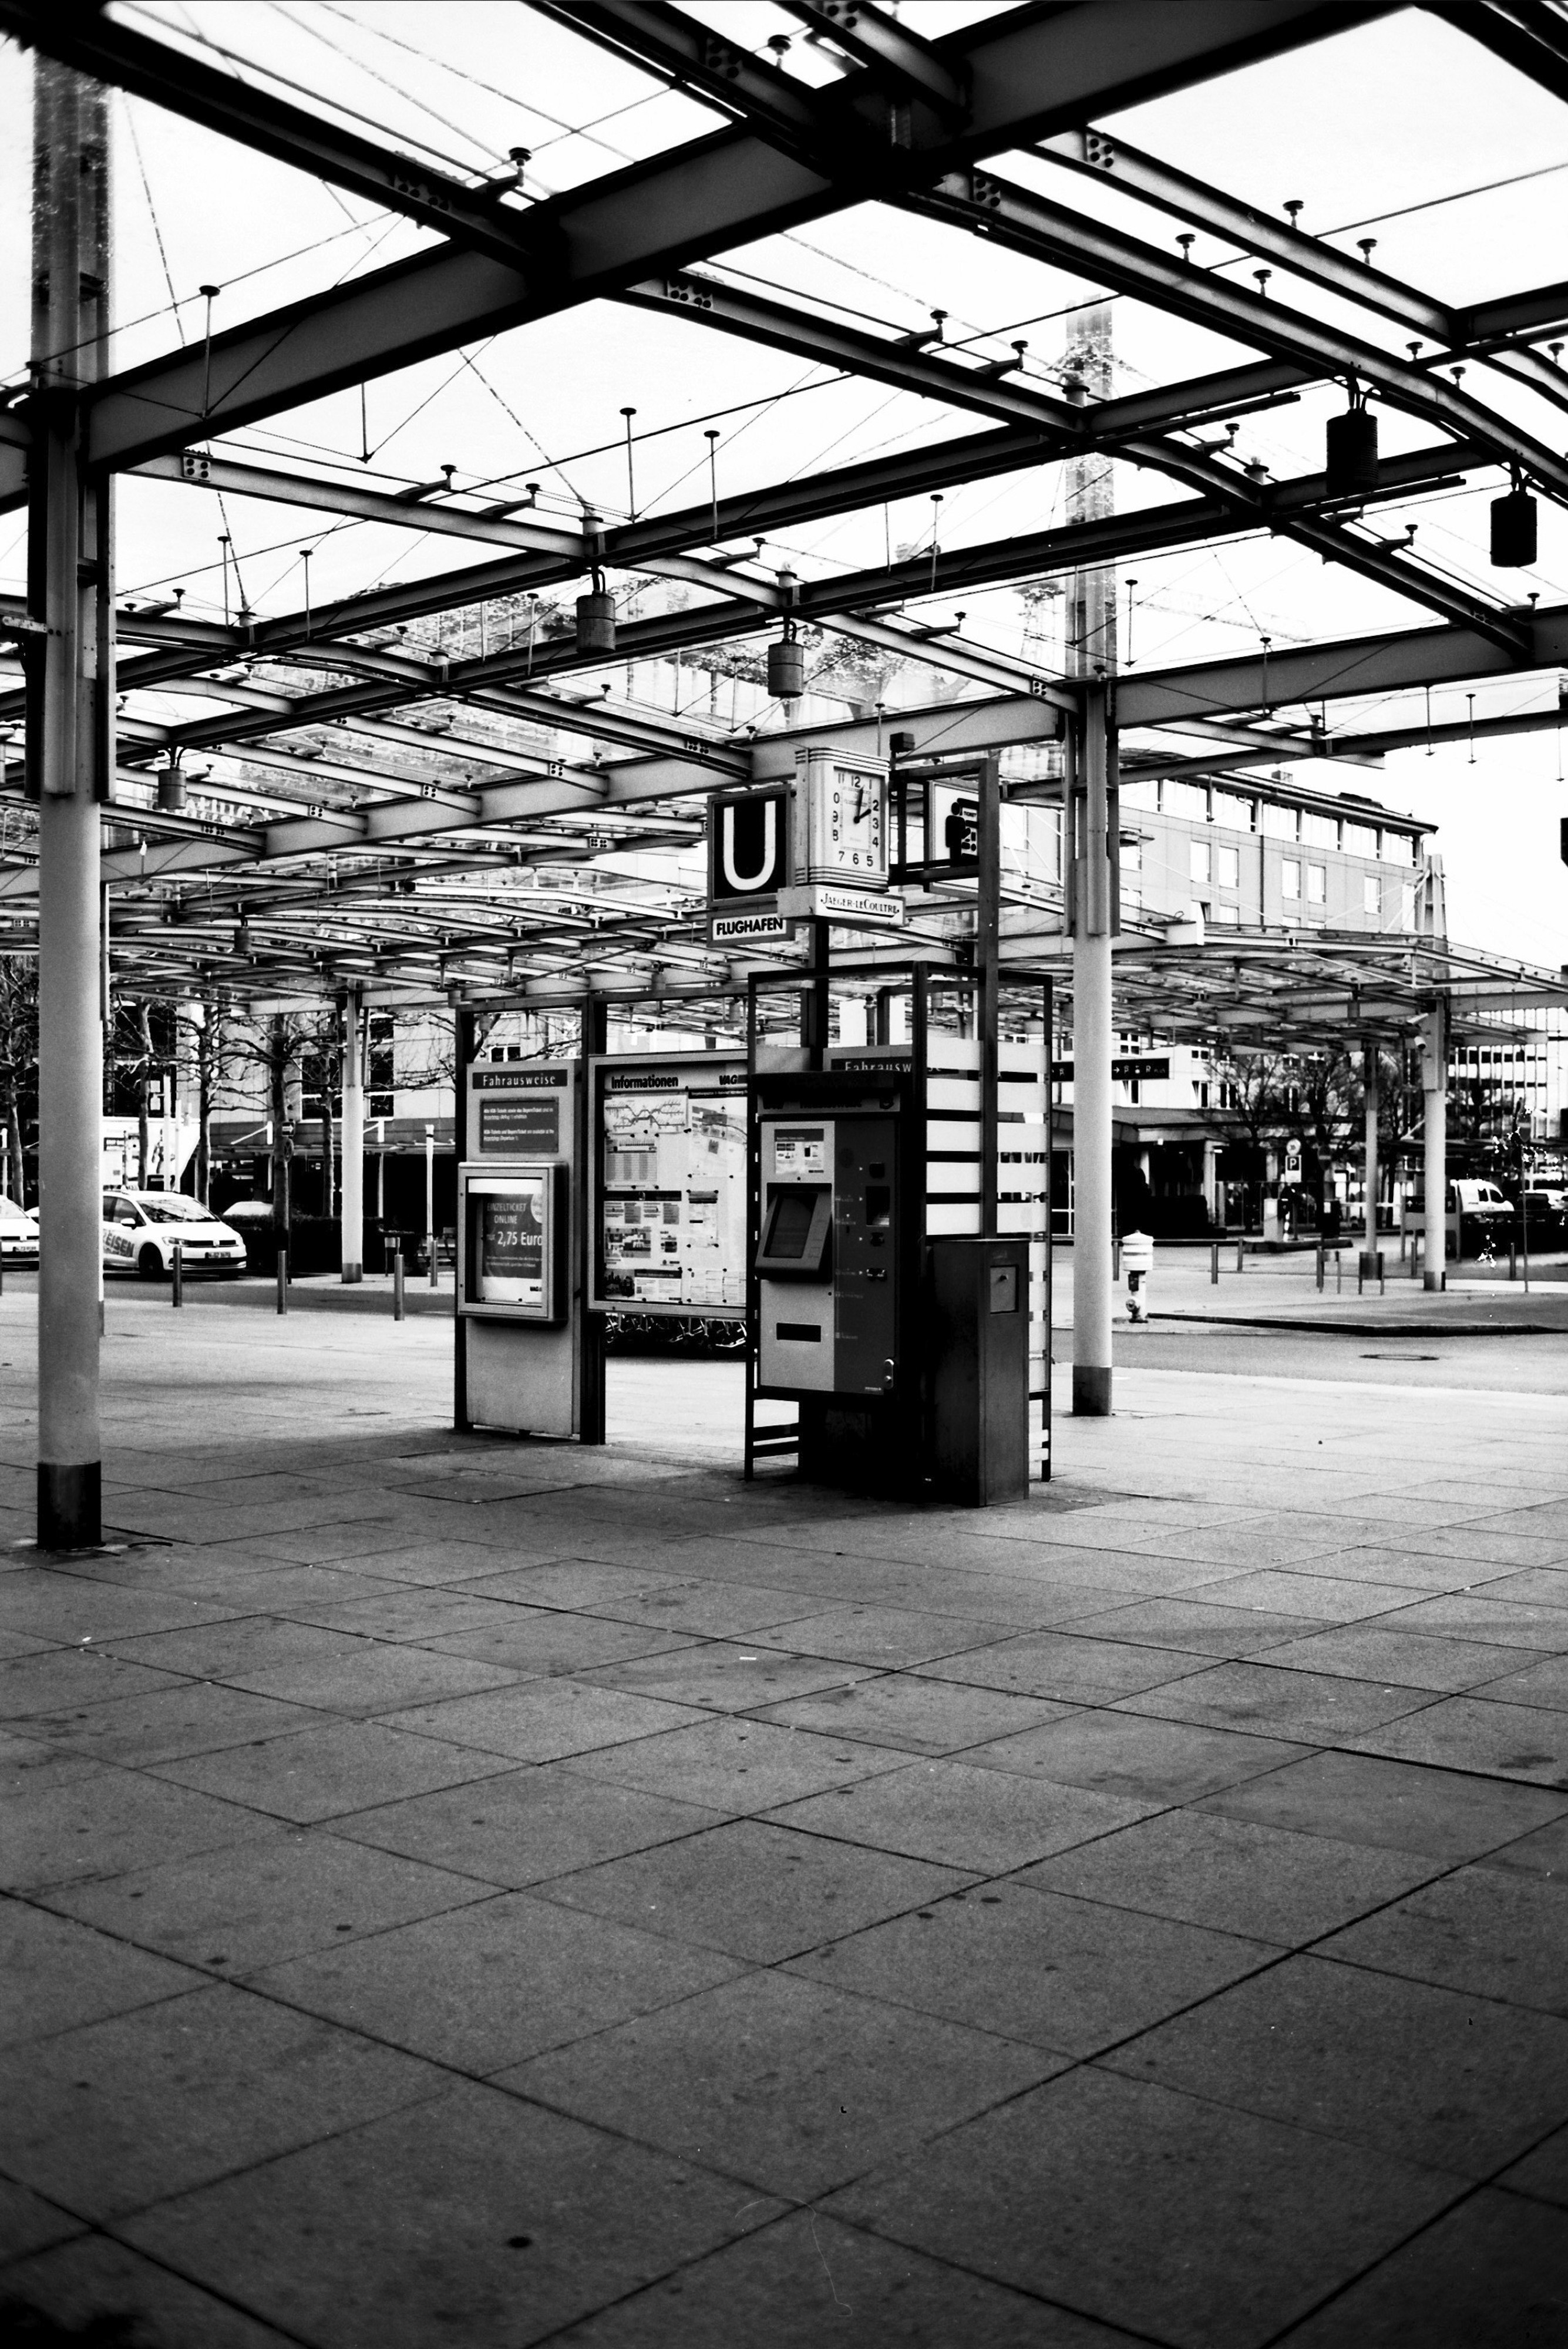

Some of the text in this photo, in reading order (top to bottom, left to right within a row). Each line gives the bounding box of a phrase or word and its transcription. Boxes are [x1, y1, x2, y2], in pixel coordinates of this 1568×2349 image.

[851, 775, 861, 788] 12
[872, 799, 880, 812] 2
[833, 810, 839, 823] 9
[872, 817, 879, 830] 3
[832, 829, 839, 842] 8
[872, 836, 879, 848] 4
[723, 800, 777, 891] U
[838, 850, 873, 867] 7 6 5
[715, 916, 783, 935] FLUGHAFEN
[483, 1072, 556, 1086] Fahrausweise
[611, 1074, 738, 1089] Informationen VAG
[1290, 1157, 1297, 1170] P
[494, 1214, 518, 1224] ONLINE
[497, 1231, 518, 1247] 2,75
[521, 1231, 543, 1246] Euro
